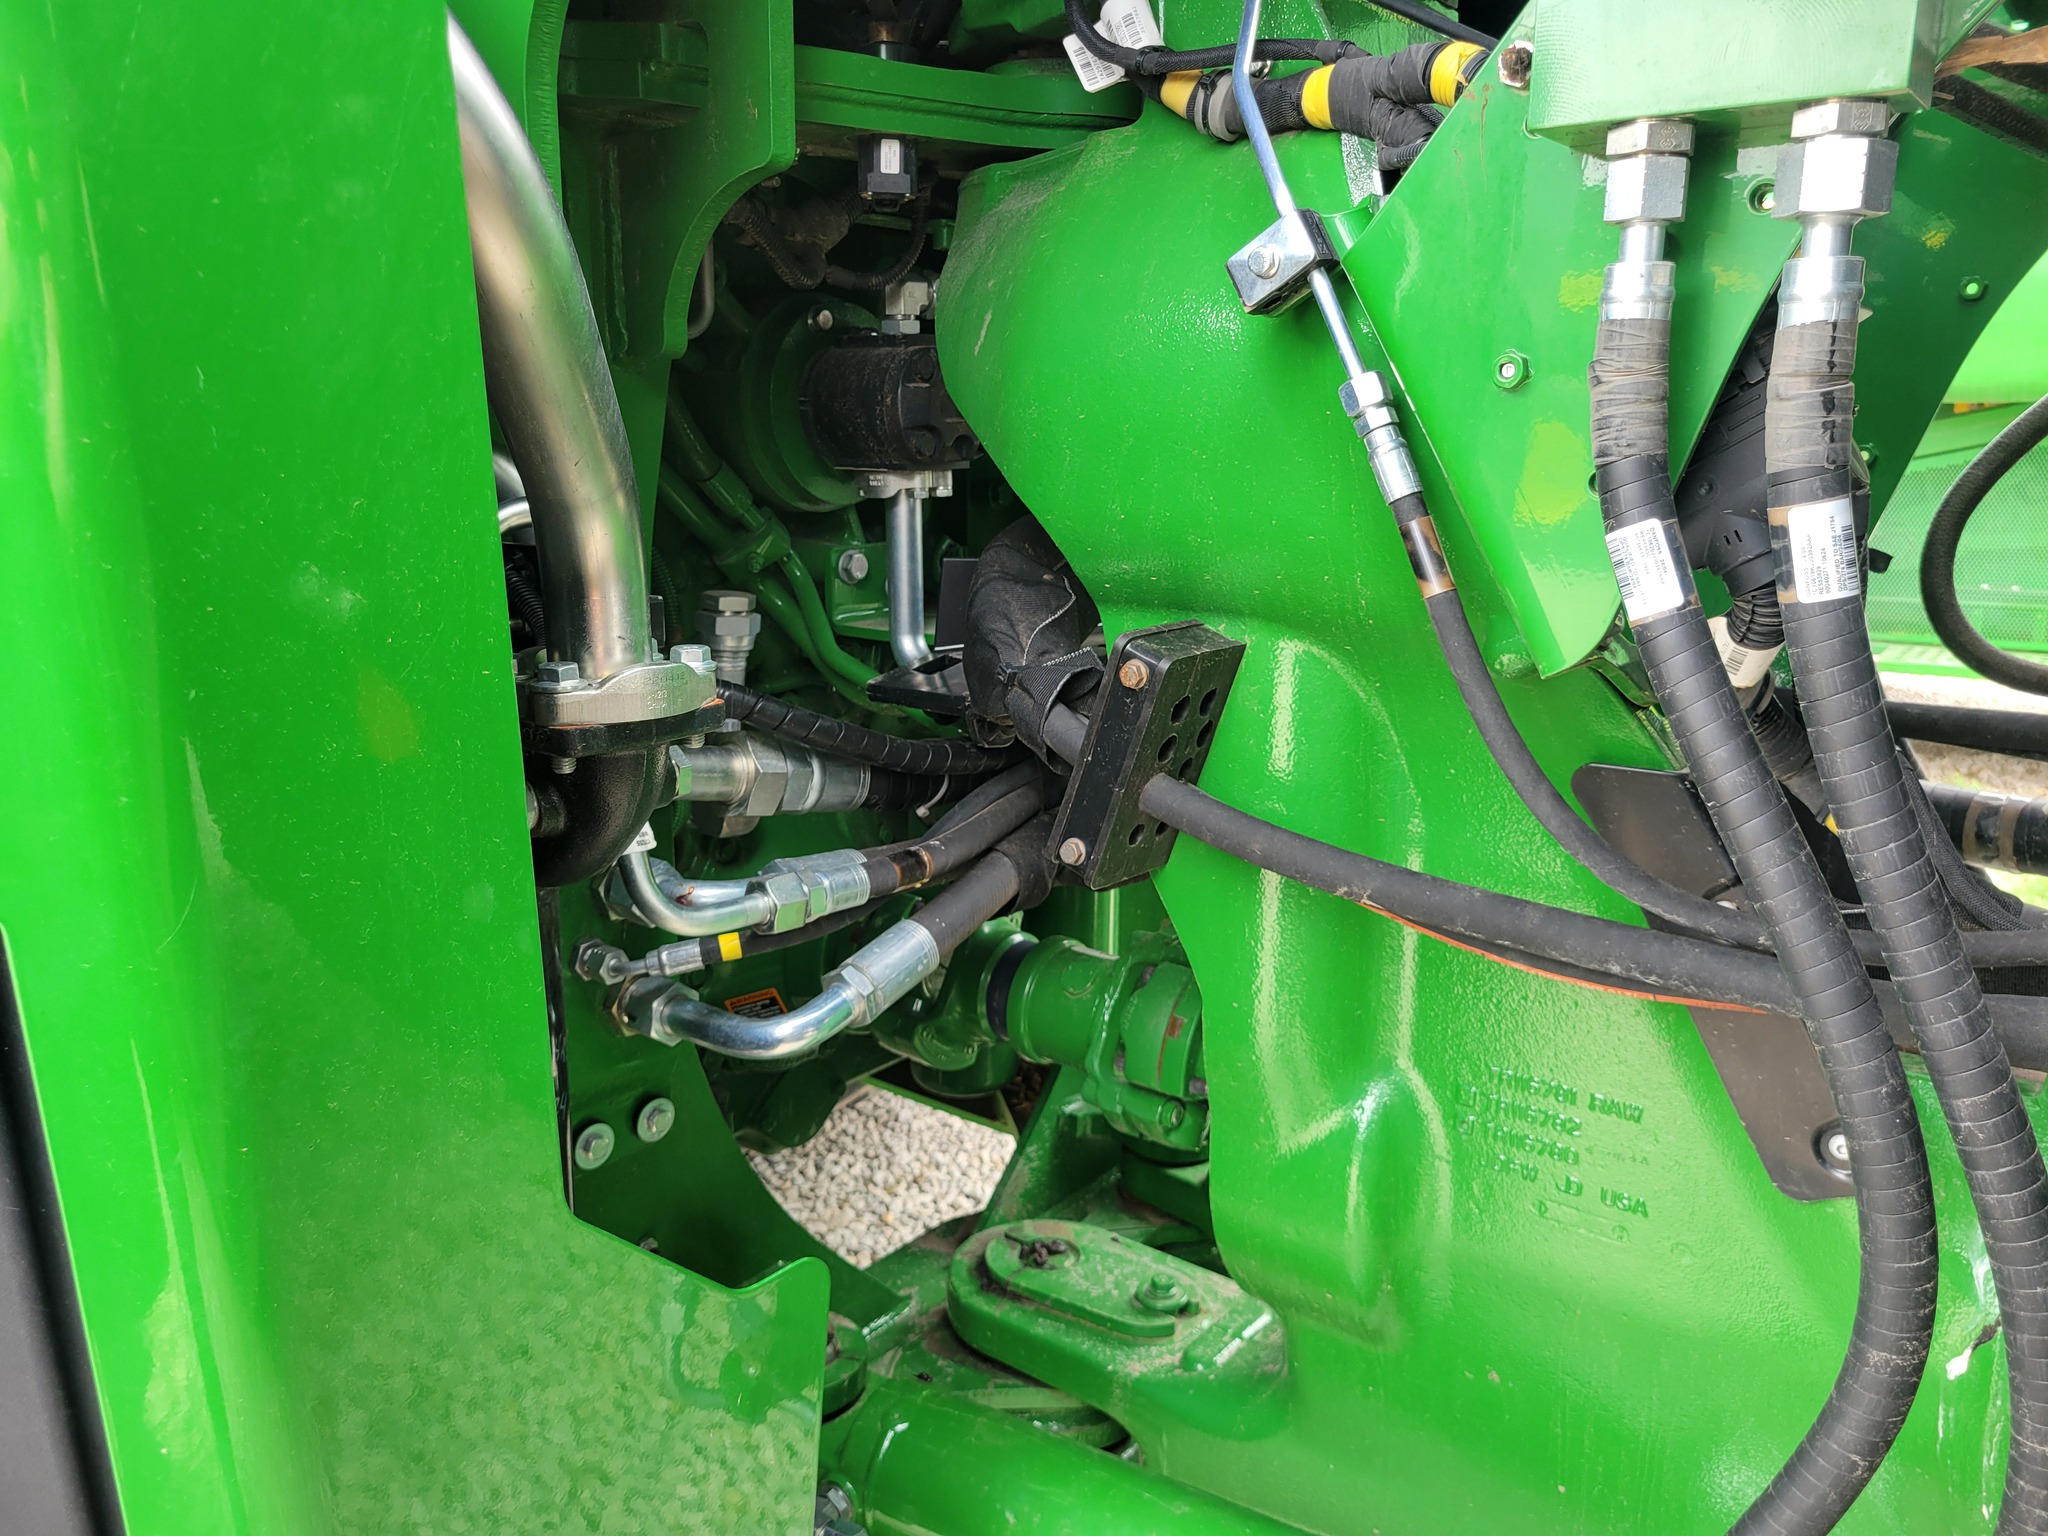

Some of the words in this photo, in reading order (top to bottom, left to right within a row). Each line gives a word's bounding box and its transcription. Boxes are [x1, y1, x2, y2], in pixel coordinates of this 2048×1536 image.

[1833, 548, 1838, 556] TO
[1834, 558, 1843, 591] QUALIFIED
[1588, 1091, 1644, 1124] RAW
[1555, 1174, 1584, 1197] JD
[1599, 1185, 1649, 1217] USA
